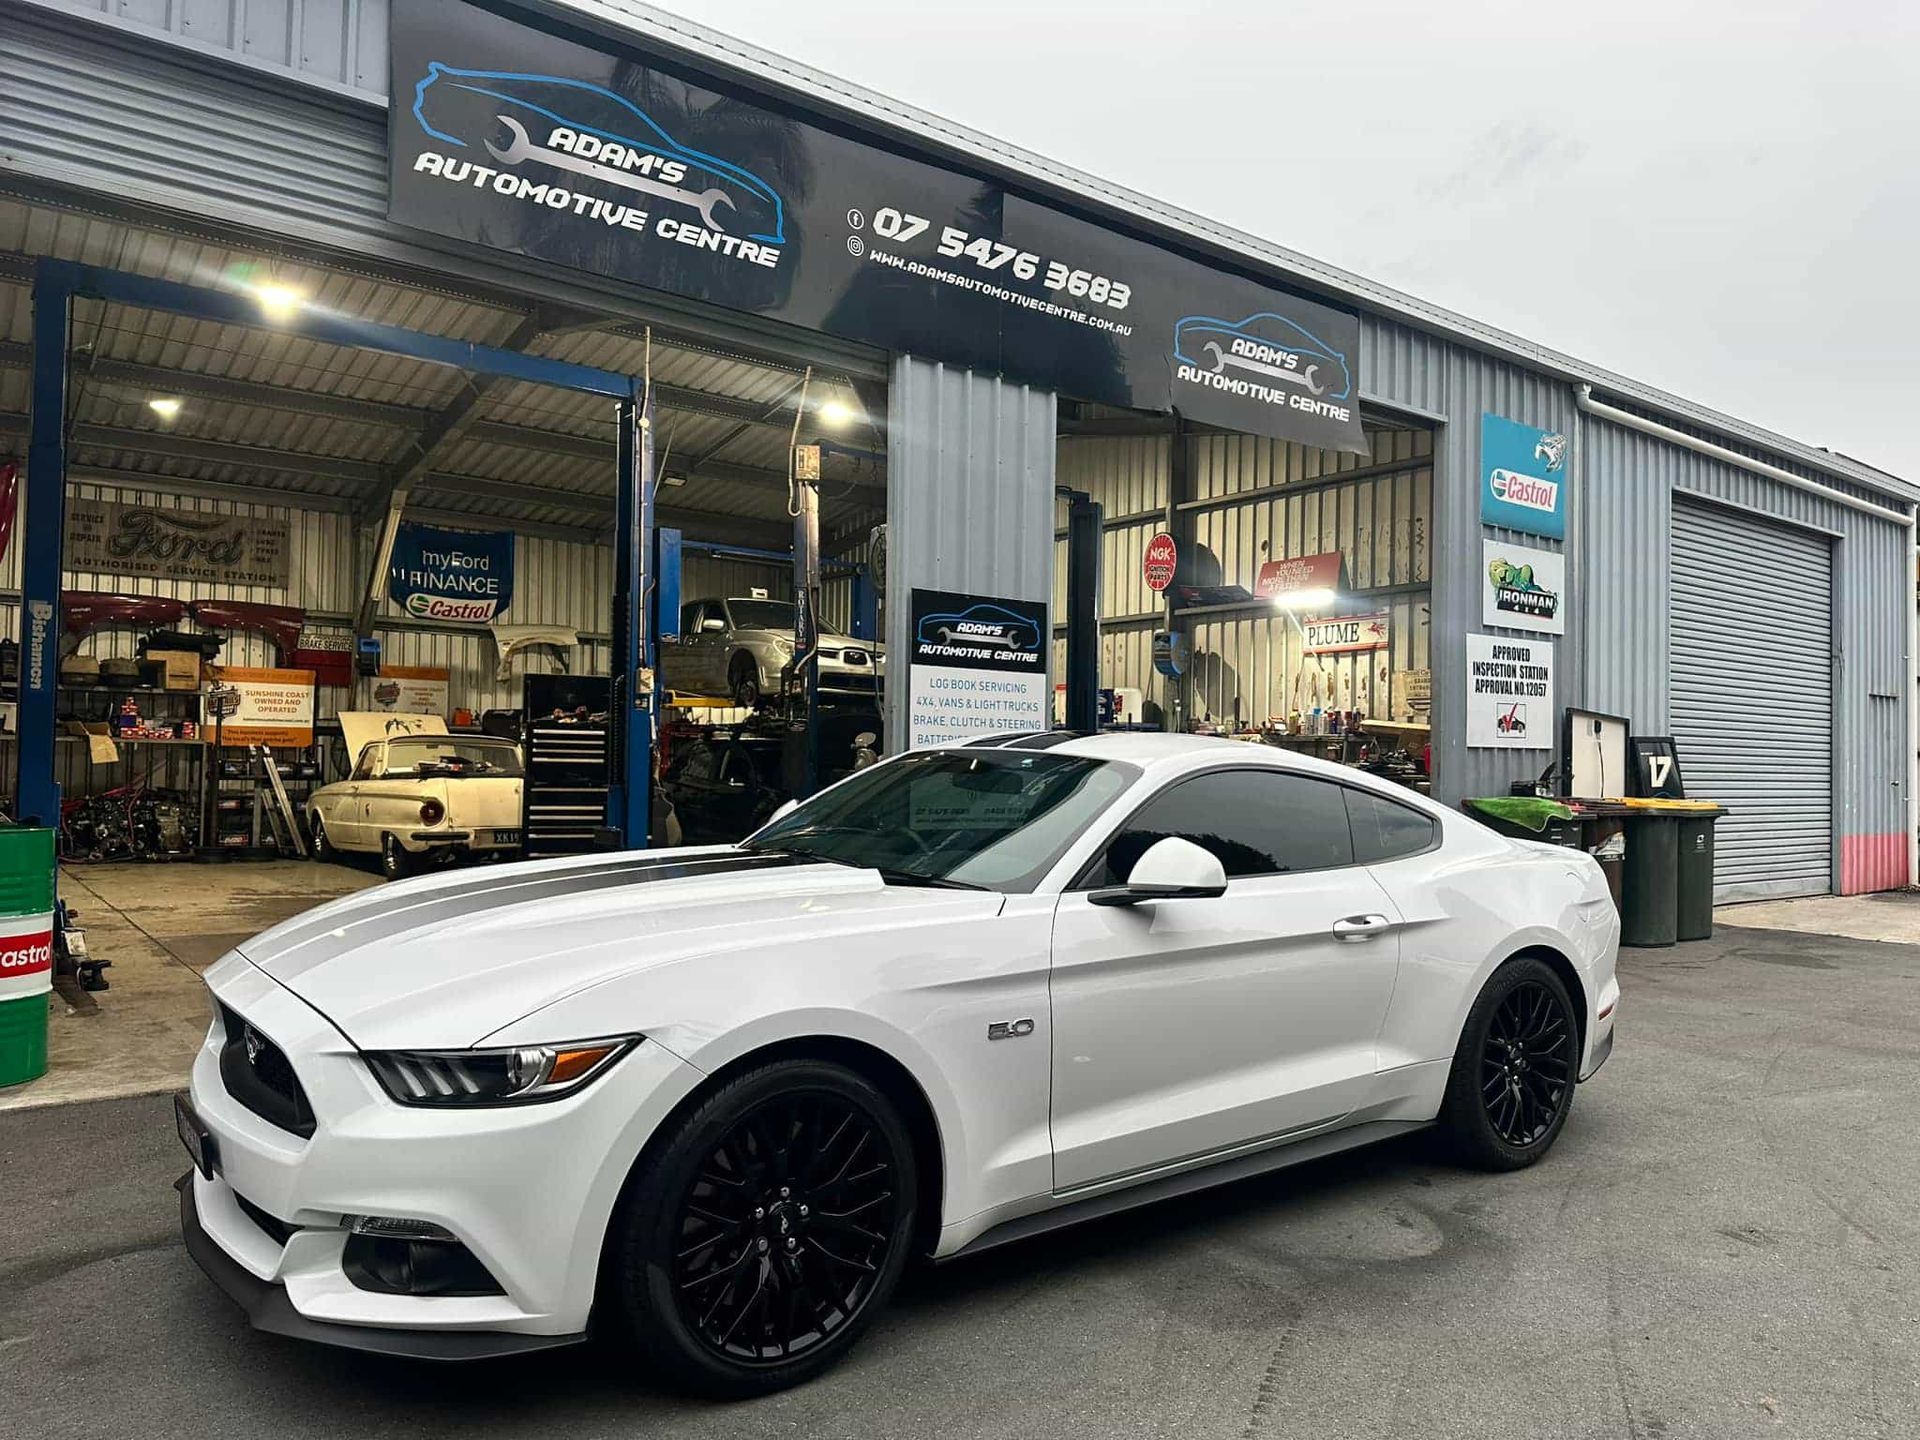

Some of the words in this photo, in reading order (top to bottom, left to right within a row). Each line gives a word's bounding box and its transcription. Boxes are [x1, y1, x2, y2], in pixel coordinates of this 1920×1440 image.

[547, 126, 688, 184] ADAM'S
[413, 152, 649, 232] AUTOMOTIVE
[656, 217, 782, 269] CENTRE
[872, 206, 931, 242] 07
[936, 225, 1041, 281] 5476
[1043, 261, 1133, 310] 3683
[869, 249, 1133, 337] WWW.ADAMSAUTOMOTIVECENTRE.COM.AU
[1231, 338, 1300, 369] ADAM'S
[1176, 364, 1286, 406] AUTOMOTIVE
[1289, 393, 1350, 422] CENTRE
[1507, 475, 1553, 508] Castrol
[109, 509, 244, 568] Ford
[422, 550, 489, 571] myFord
[1150, 547, 1172, 561] NGK
[73, 557, 158, 572] AUTHORISED
[166, 565, 217, 577] SERVICE
[223, 570, 277, 583] STATION
[409, 570, 500, 595] FINANCE
[429, 600, 491, 619] Castrol
[1499, 589, 1553, 610] IRONMAN
[956, 622, 1004, 636] ADAM'S
[1308, 621, 1360, 646] PLUME
[299, 636, 322, 648] BRAKE
[323, 639, 353, 652] SERVICE
[918, 644, 993, 660] AUTOMOTIVE
[993, 650, 1039, 663] CENTRE
[1492, 644, 1531, 663] APPROVED
[1472, 660, 1517, 679] INSPECTION
[1519, 664, 1549, 681] STATION
[245, 689, 285, 699] SUNSHINE
[286, 691, 309, 699] COAST
[929, 677, 949, 690] LOG
[951, 678, 977, 692] BOOK
[979, 680, 1027, 694] SERVICING
[1474, 678, 1513, 695] APPROVAL
[254, 698, 284, 706] OWNED
[285, 699, 302, 707] AND
[258, 706, 298, 714] OPERATED
[939, 697, 965, 710] VANS
[965, 698, 973, 710] &
[974, 699, 1001, 712] LIGHT
[1003, 700, 1039, 713] TRUCKS
[913, 713, 949, 727] BRAKE,
[950, 715, 990, 728] CLUTCH
[989, 718, 998, 729] &
[997, 719, 1041, 731] STEERING
[1649, 756, 1671, 787] 17
[0, 941, 51, 967] astrol
[988, 1019, 1035, 1040] 5.0
